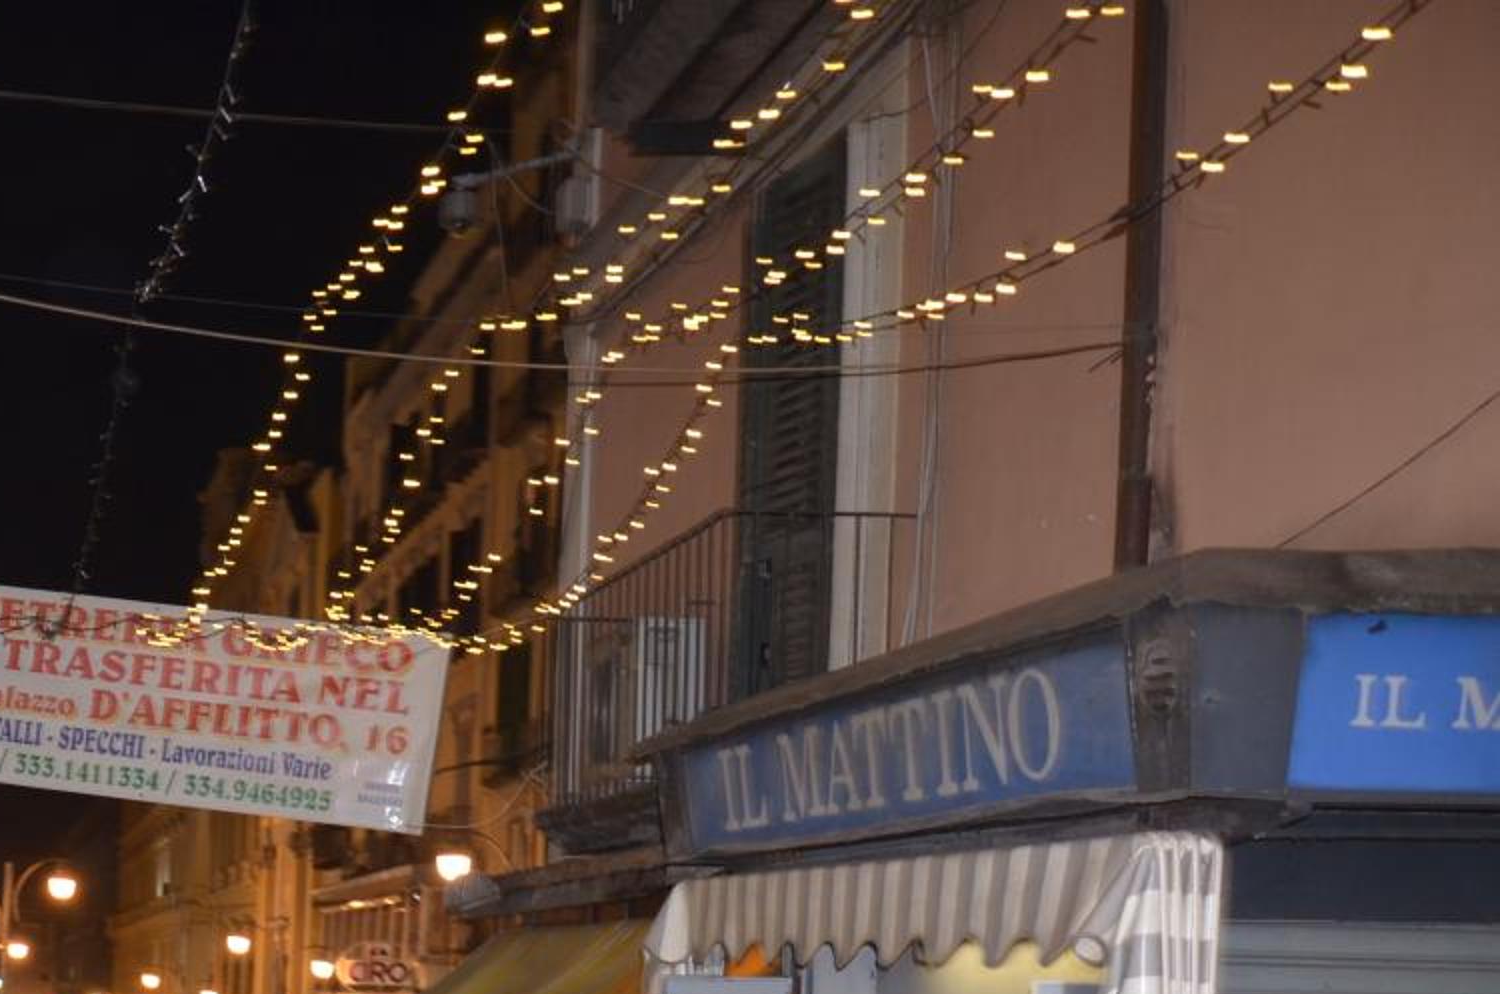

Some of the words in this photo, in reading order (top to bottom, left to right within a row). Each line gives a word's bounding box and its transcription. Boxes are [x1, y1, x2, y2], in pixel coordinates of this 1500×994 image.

[3, 638, 302, 704] TRASFERITA
[316, 674, 410, 715] NEL
[1350, 672, 1427, 728] IL
[57, 725, 146, 760] SPECCHI
[161, 737, 277, 776] Lavorazioni
[282, 750, 333, 781] Varie
[366, 724, 409, 755] 16
[717, 745, 771, 832] IL
[775, 668, 1062, 823] MATTINO
[14, 752, 161, 792] 333.1411334
